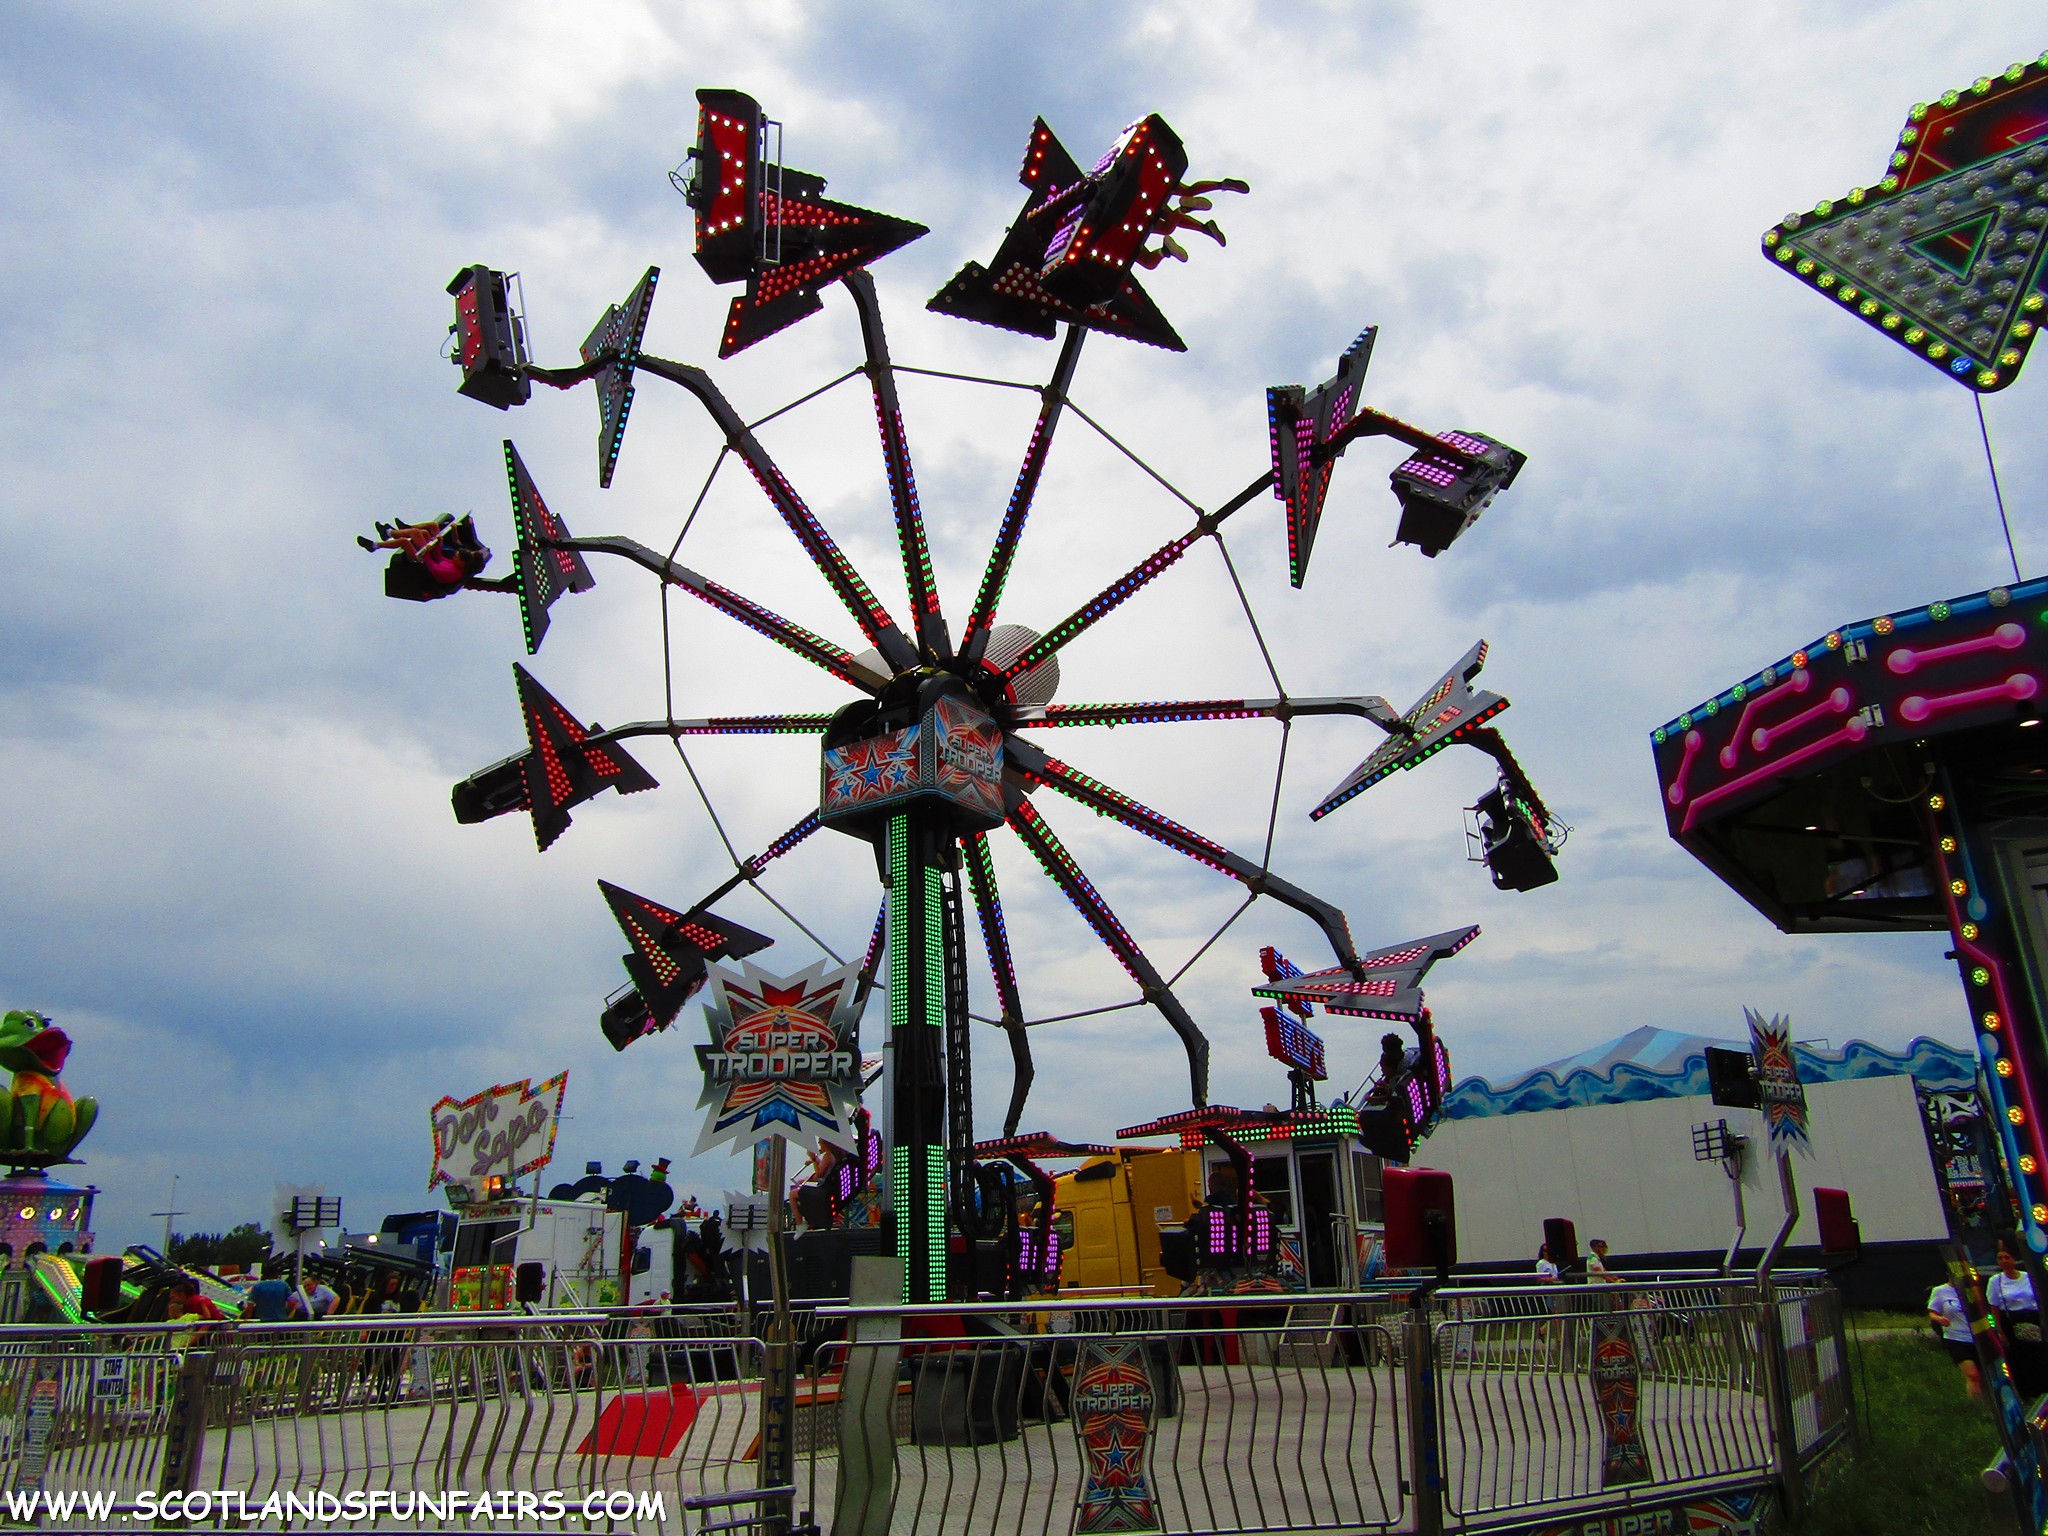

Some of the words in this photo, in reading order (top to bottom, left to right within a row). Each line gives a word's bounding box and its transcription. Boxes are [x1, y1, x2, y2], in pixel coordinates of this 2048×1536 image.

[952, 736, 991, 764] SUPER
[941, 746, 1001, 783] TROOPER
[738, 1031, 820, 1051] SUPER
[706, 1052, 853, 1079] TROOPER
[1766, 1065, 1791, 1080] SUPER
[1759, 1080, 1802, 1101] TROOPER
[435, 1095, 499, 1160] Don
[470, 1101, 549, 1177] Sapo
[468, 1205, 513, 1219] CONTROL
[103, 1359, 123, 1377] STAFF
[97, 1379, 124, 1396] WANTED
[1092, 1383, 1135, 1396] SUPER
[1075, 1395, 1152, 1411] TROOPER
